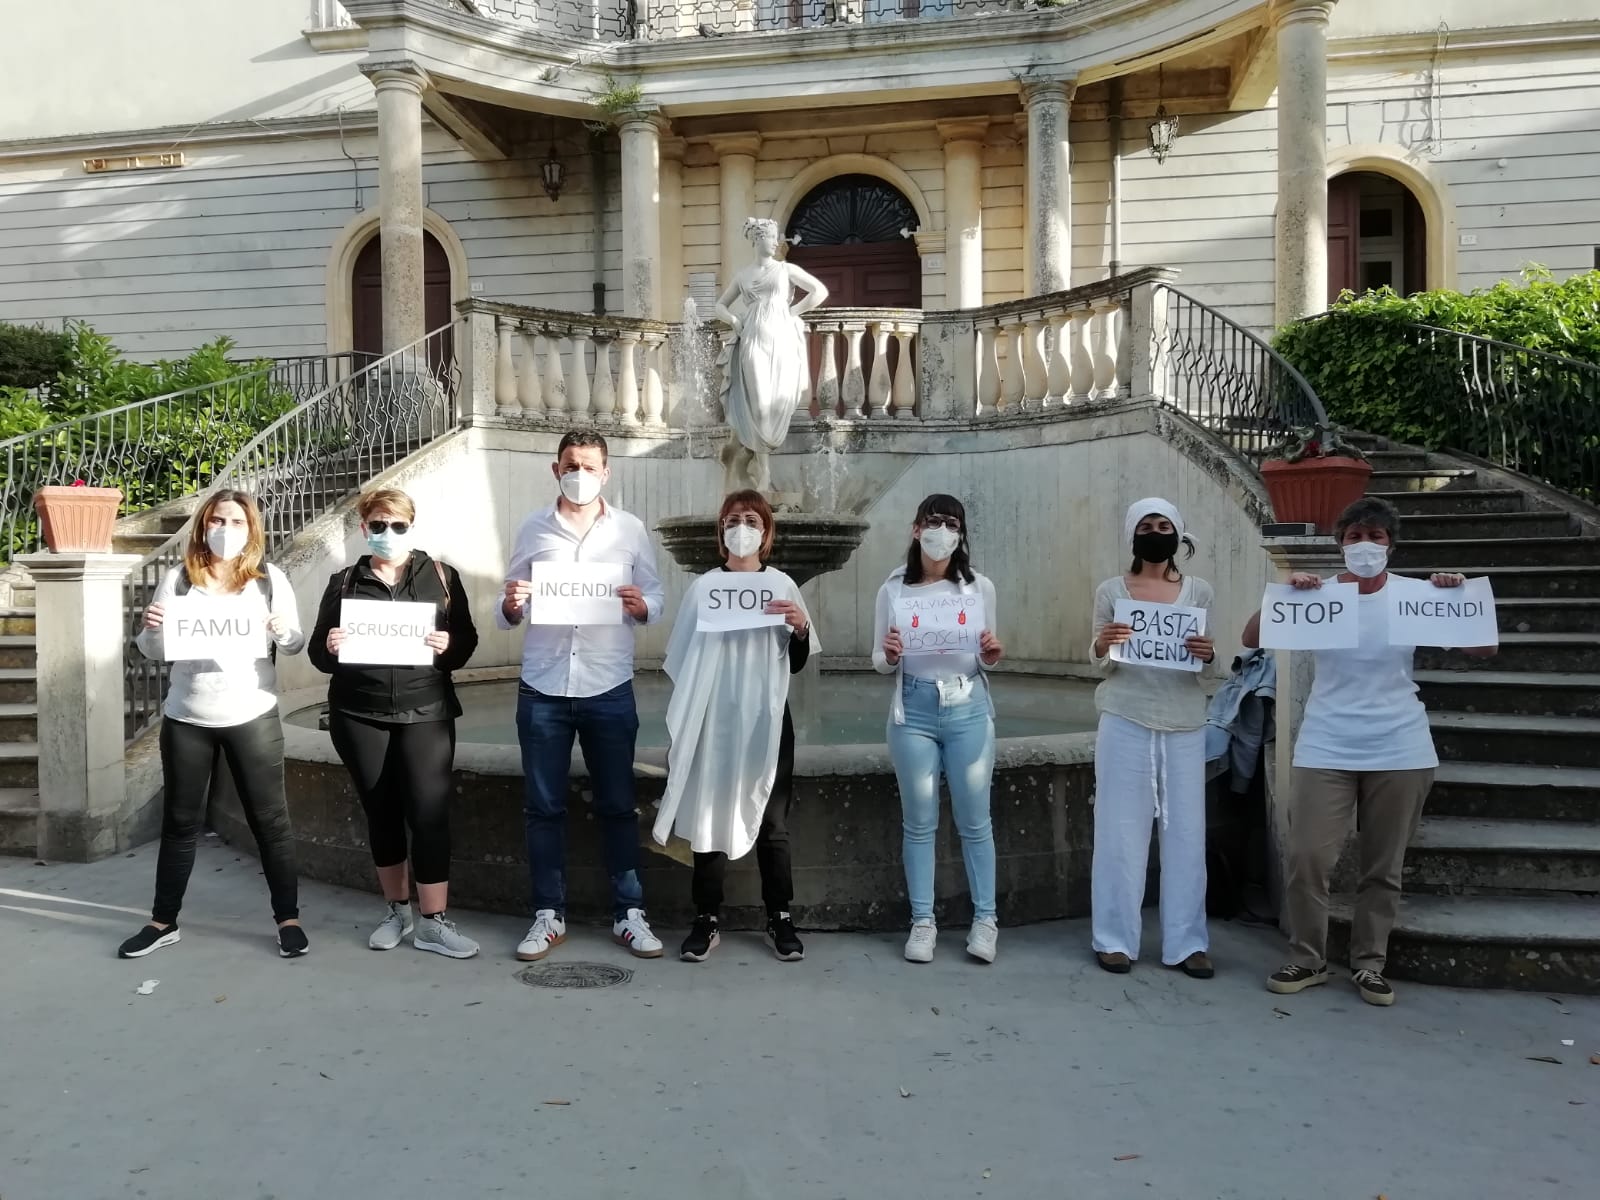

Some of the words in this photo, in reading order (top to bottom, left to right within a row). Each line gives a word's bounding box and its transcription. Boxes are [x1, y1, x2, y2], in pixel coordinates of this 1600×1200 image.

[540, 582, 612, 598] INCENDI
[708, 588, 774, 610] STOP
[904, 598, 976, 610] SALVIAMO
[1271, 601, 1344, 625] STOP
[1398, 601, 1484, 618] INCENDI
[177, 618, 251, 638] FAMU
[347, 622, 426, 638] SCRUSCIU
[1130, 609, 1200, 639] BASTA
